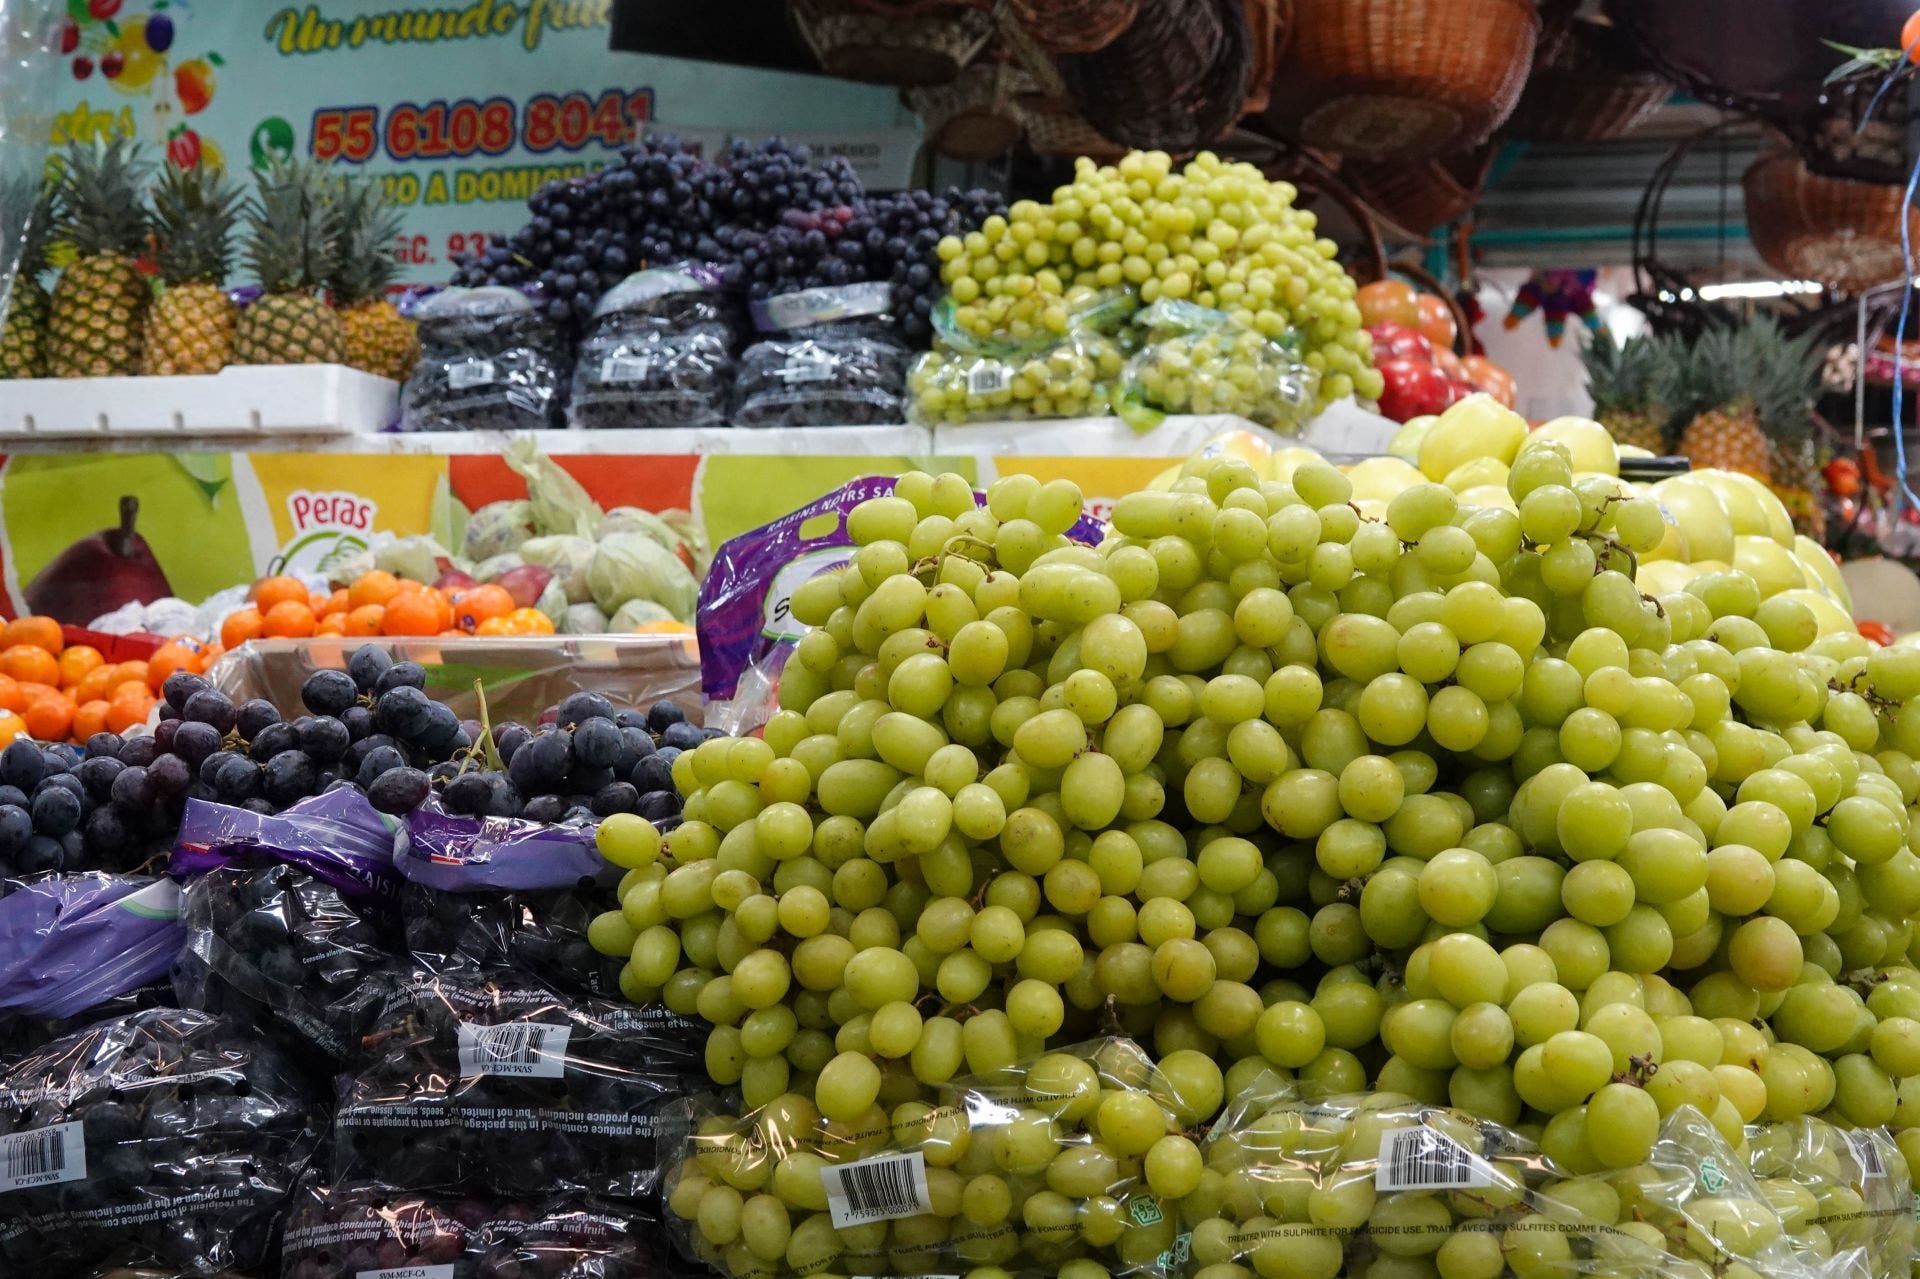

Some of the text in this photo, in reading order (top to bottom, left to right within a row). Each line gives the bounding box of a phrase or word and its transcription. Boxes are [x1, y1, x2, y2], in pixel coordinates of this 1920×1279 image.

[264, 4, 342, 55] Un
[348, 0, 517, 47] mundo
[310, 87, 656, 163] 55 6108 8041
[293, 496, 371, 530] Peras
[766, 504, 817, 533] RAISINS
[821, 487, 866, 511] NOIRS
[1010, 1096, 1036, 1105] WITH
[461, 1107, 495, 1118] limited
[496, 1107, 514, 1118] not
[587, 1112, 629, 1124] produce
[371, 1116, 410, 1128] propagate
[411, 1118, 420, 1128] to
[419, 1117, 433, 1128] not
[464, 1117, 507, 1131] package
[508, 1119, 528, 1131] this
[529, 1120, 539, 1132] in
[631, 1114, 648, 1126] the
[591, 1126, 632, 1137] produce
[635, 1127, 650, 1138] the
[185, 1190, 221, 1203] portion
[222, 1188, 241, 1200] any
[114, 1201, 153, 1214] produce
[154, 1198, 172, 1209] the
[120, 1210, 160, 1226] produce
[161, 1208, 178, 1219] the
[311, 1222, 338, 1237] produce
[339, 1219, 382, 1230] contained
[562, 1223, 581, 1233] and
[583, 1224, 608, 1237] fruit.
[1228, 1232, 1259, 1244] TREATED
[1260, 1229, 1281, 1240] WITH
[1283, 1227, 1328, 1238] SULPHITE
[1329, 1226, 1348, 1236] FOR
[1402, 1225, 1424, 1235] USE.
[1462, 1223, 1487, 1233] AVEC
[1488, 1223, 1508, 1233] DES
[1510, 1223, 1556, 1233] SULFITES
[1558, 1223, 1597, 1234] COMME
[313, 1233, 341, 1247] produce
[342, 1230, 381, 1242] including
